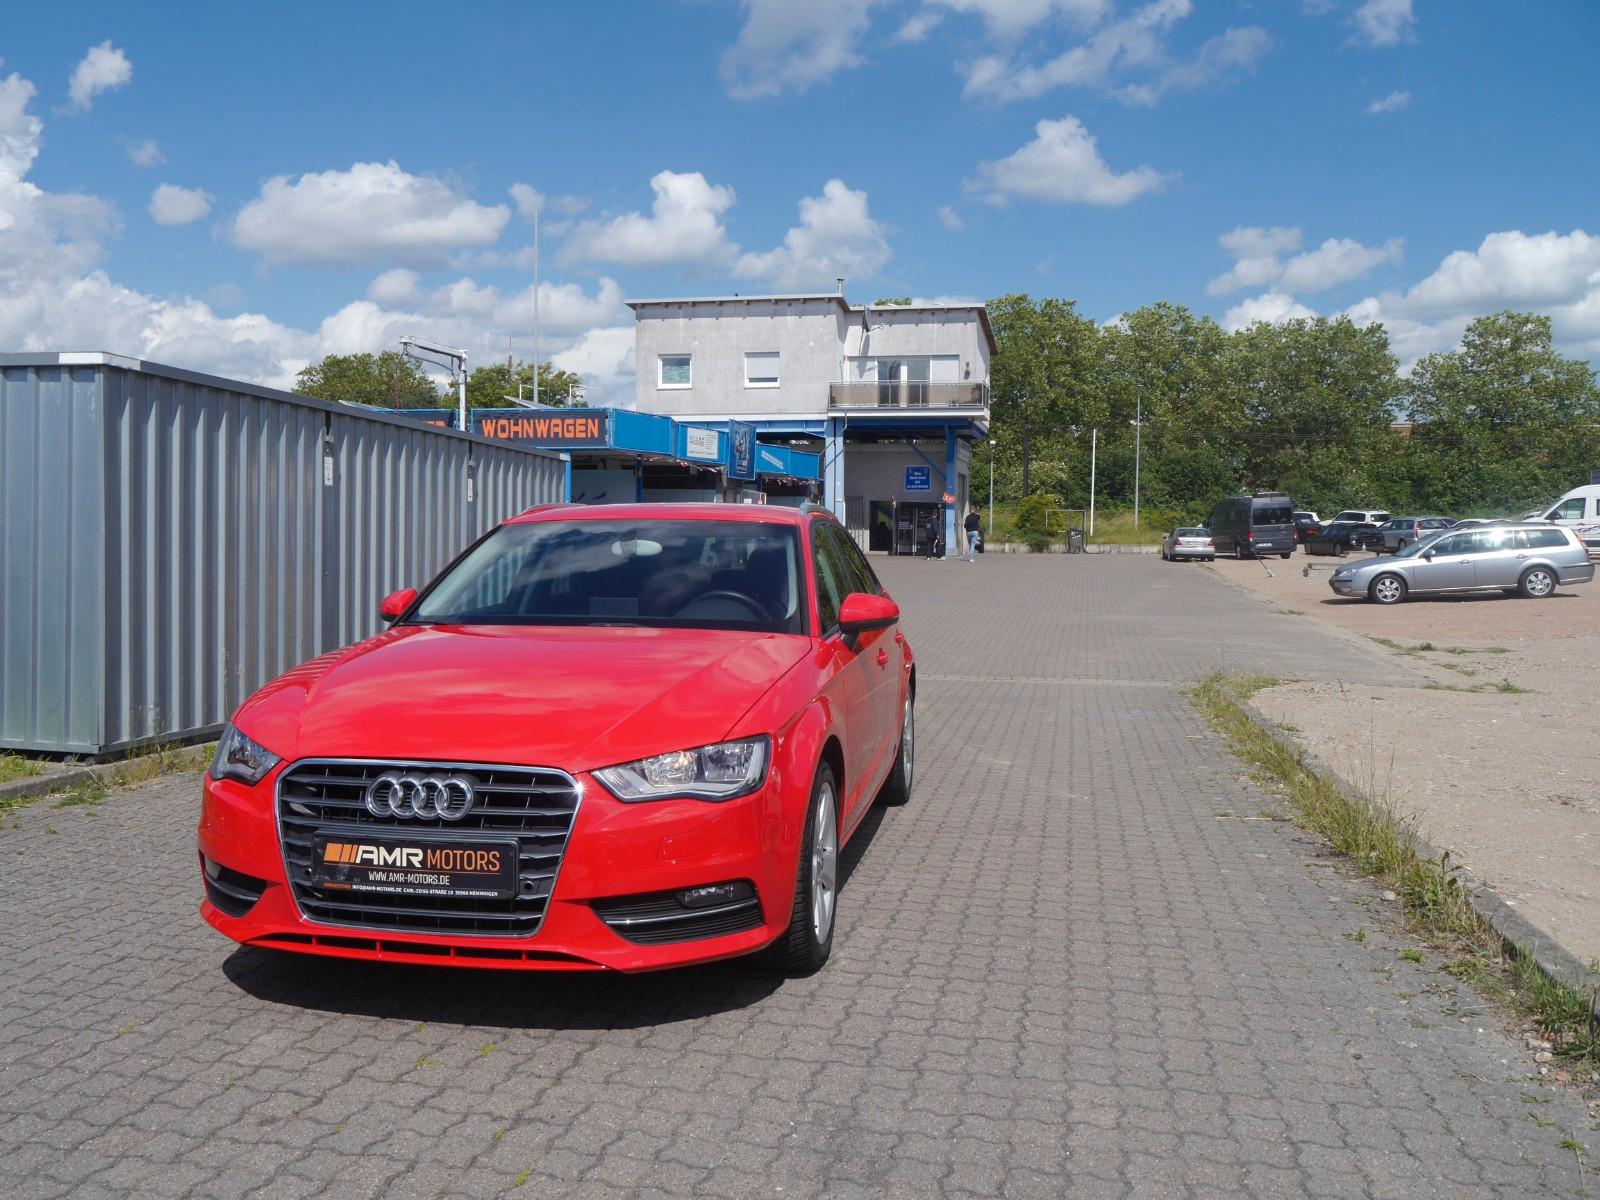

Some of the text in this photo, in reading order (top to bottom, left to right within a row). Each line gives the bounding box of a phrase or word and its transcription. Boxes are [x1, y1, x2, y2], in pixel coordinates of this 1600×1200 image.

[482, 418, 599, 439] WOHNWAGEN
[355, 845, 500, 871] AMR MOTORS
[368, 871, 450, 886] WWW.AMR-MOTORS.DE
